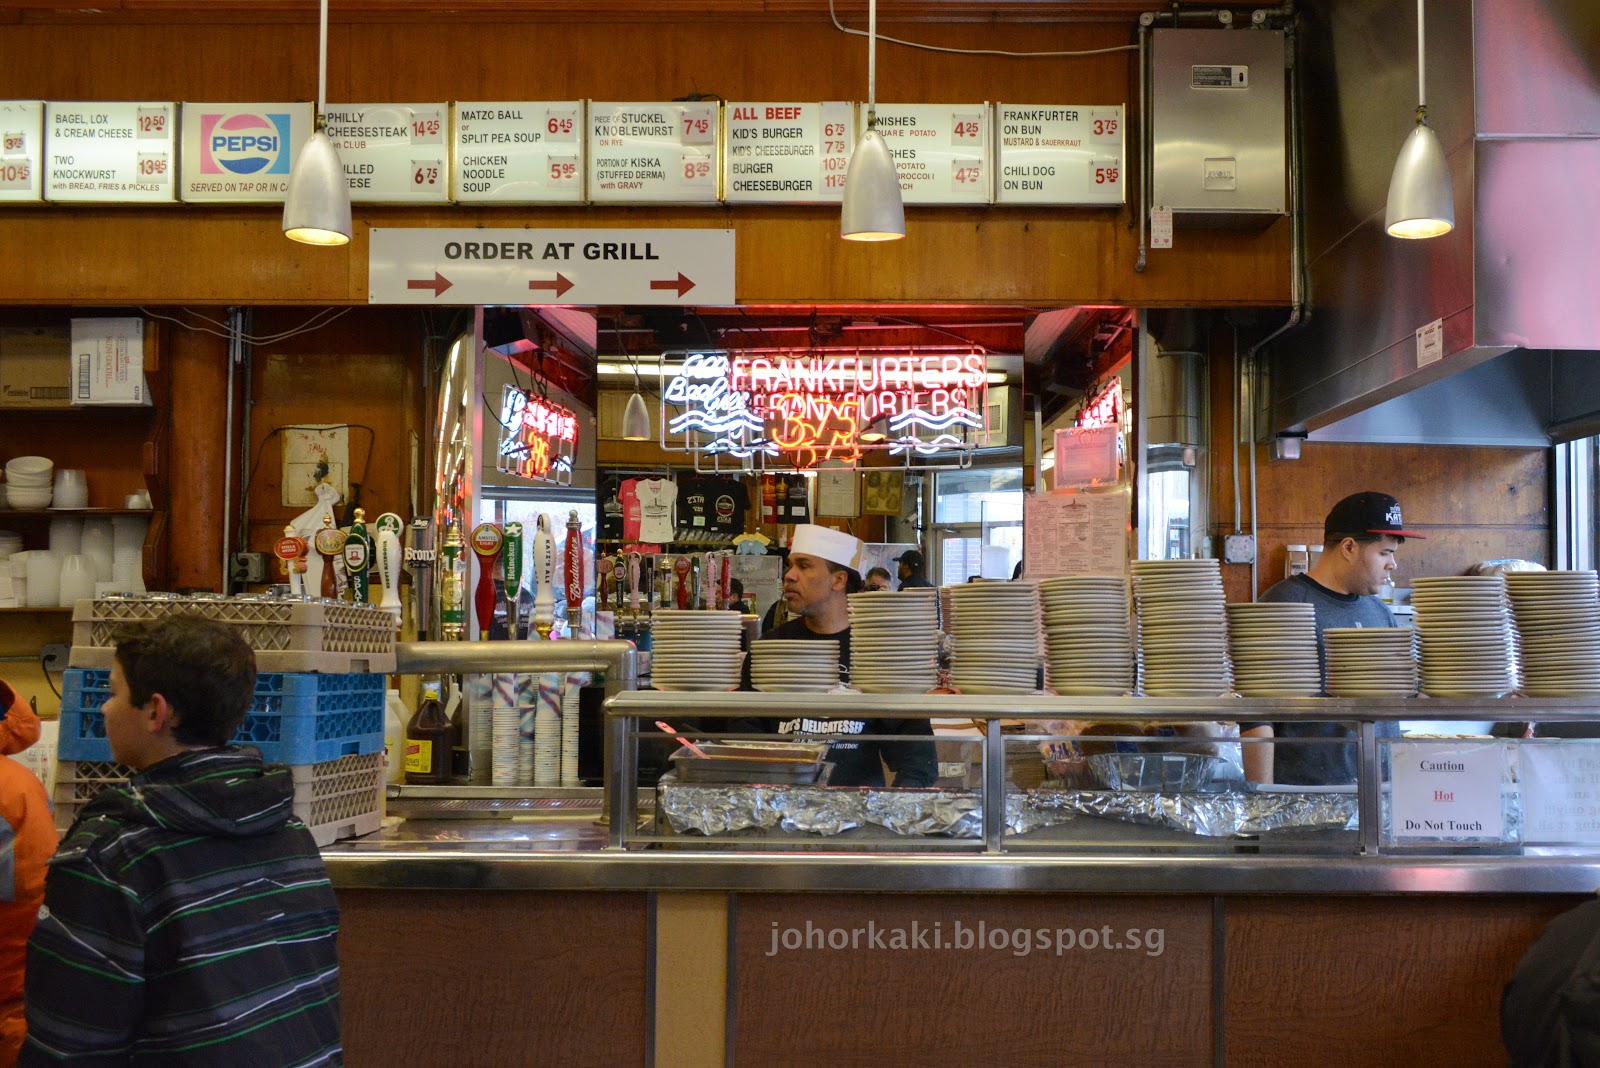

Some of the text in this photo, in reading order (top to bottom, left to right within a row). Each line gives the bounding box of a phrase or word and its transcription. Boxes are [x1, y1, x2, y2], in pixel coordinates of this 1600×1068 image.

[327, 112, 365, 123] PHILLY
[461, 110, 523, 121] MATZO BALL
[621, 113, 666, 124] STUCKEL
[733, 107, 802, 120] ALL BEEF
[1003, 110, 1079, 122] FRANKFURTER
[55, 114, 109, 126] BAGEL, LOX
[876, 116, 917, 126] NISHES
[55, 127, 133, 139] & CREAM CHEESE
[327, 127, 408, 137] CHEESESTEAK
[594, 125, 674, 136] KNOBLEWURST
[732, 128, 803, 139] KID'S BURGER
[877, 129, 904, 137] UARE
[1003, 125, 1042, 135] ON BUN
[461, 132, 542, 144] SPLIT PEA SOUP
[1003, 137, 1082, 147] MUSTARD & SAUERKRAUT
[212, 136, 278, 152] PEPSI
[343, 141, 366, 149] CLUB
[732, 145, 814, 156] KID'S CHEESEBURGER
[889, 149, 916, 159] SHES
[54, 155, 75, 166] TWO
[462, 155, 508, 166] CHICKEN
[596, 158, 661, 168] PORTION OF KISKA
[896, 162, 926, 170] POTATO
[343, 164, 374, 175] ILLED
[462, 169, 505, 179] NOODLE
[733, 163, 773, 174] BURGER
[1003, 166, 1056, 176] CHILI DOG
[53, 169, 116, 180] KNOCKWURST
[596, 170, 666, 180] (STUFFED DERMA)
[52, 182, 160, 192] with BREAD, FRIES & PICKLES
[190, 182, 223, 192] SERVED
[224, 182, 237, 192] ON
[239, 182, 254, 192] TAP
[255, 182, 268, 192] OR
[269, 182, 278, 192] IN
[462, 182, 491, 193] SOUP
[617, 181, 643, 190] GRAVY
[733, 180, 813, 191] CHEESEBURGER
[1003, 180, 1043, 191] ON BUN
[444, 242, 659, 260] ORDER AT GRILL
[729, 353, 985, 392] FRANKFURTERS
[404, 547, 436, 561] Bronx
[507, 541, 516, 580] Heineken
[570, 536, 579, 601] Budweiser
[1420, 760, 1465, 771] Caution
[1434, 790, 1454, 801] Hot
[1405, 820, 1482, 831] Do Not Touch
